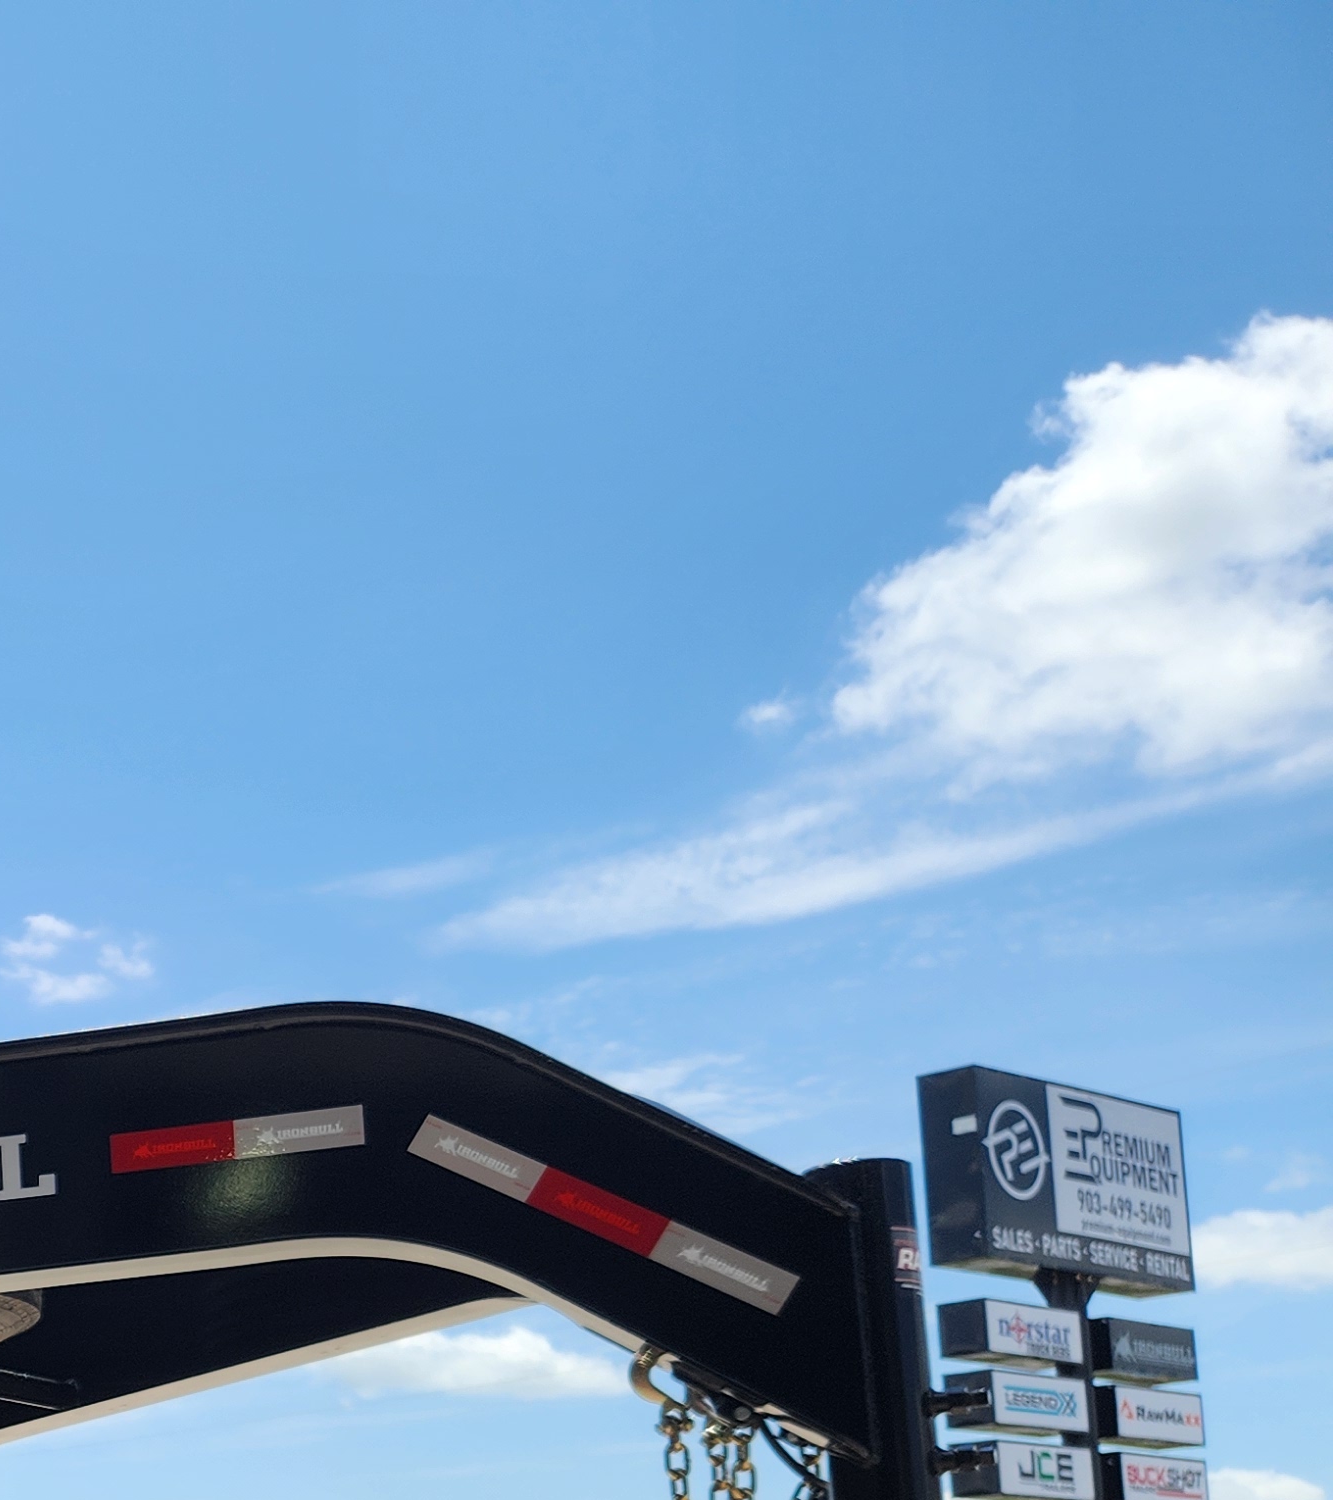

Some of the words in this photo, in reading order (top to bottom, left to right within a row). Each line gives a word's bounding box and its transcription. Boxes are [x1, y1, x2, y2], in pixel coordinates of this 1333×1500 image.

[276, 1121, 344, 1140] IRONBULL
[1059, 1096, 1172, 1168] PREMIUM
[1064, 1129, 1179, 1198] EQUIPMENT
[457, 1143, 520, 1180] IRONBULL
[702, 1254, 769, 1293] IRONBULL
[1077, 1188, 1172, 1230] 903-499-5490
[992, 1225, 1033, 1254] SALES
[1042, 1233, 1082, 1262] PARTS
[1089, 1241, 1139, 1272] SERVICE
[1017, 1450, 1074, 1482] JCE
[1126, 1464, 1202, 1490] BUCKSHOT
